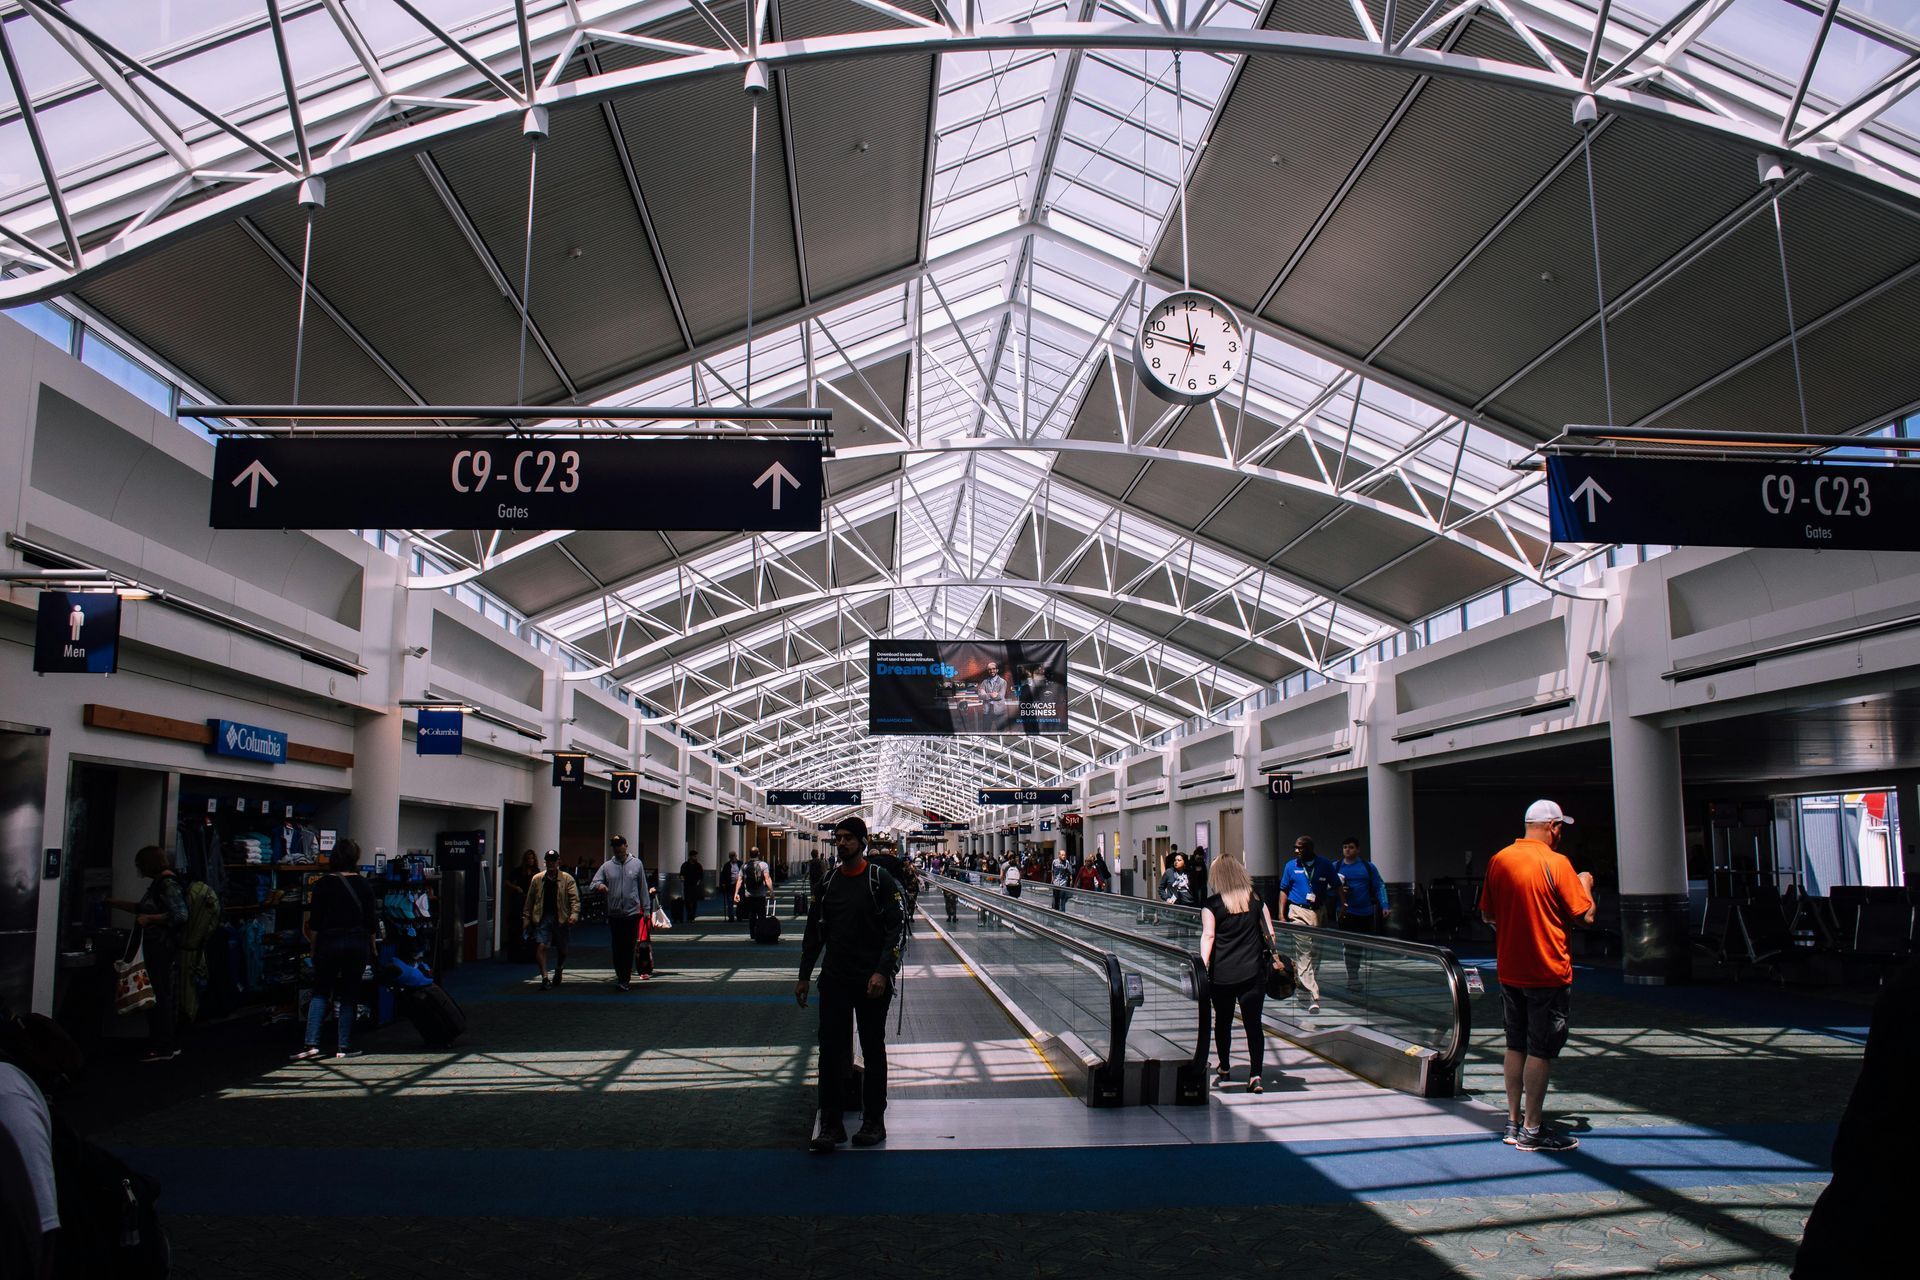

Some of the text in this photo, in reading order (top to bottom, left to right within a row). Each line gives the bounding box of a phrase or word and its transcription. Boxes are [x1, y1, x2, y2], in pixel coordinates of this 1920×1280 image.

[1164, 306, 1175, 316] 11
[1183, 300, 1197, 311] 12
[1208, 307, 1214, 318] 1
[1150, 320, 1165, 331] 10
[1222, 322, 1231, 333] 2
[1145, 338, 1154, 349] 9
[1228, 341, 1237, 352] 3
[1152, 357, 1161, 368] 8
[1222, 361, 1231, 371] 4
[1168, 373, 1176, 384] 7
[1208, 375, 1216, 385] 5
[1188, 379, 1196, 390] 6
[451, 450, 580, 494] C9-C23
[1761, 474, 1872, 517] C9-C23
[498, 504, 529, 520] Gates
[1806, 525, 1832, 540] Gates
[63, 644, 86, 658] Men
[876, 661, 959, 678] Dream Gig.
[427, 728, 459, 737] Columbia
[237, 729, 281, 757] Columbia
[617, 779, 631, 794] C9
[1272, 779, 1291, 794] C10
[734, 815, 744, 823] C11
[1065, 816, 1080, 826] Spa
